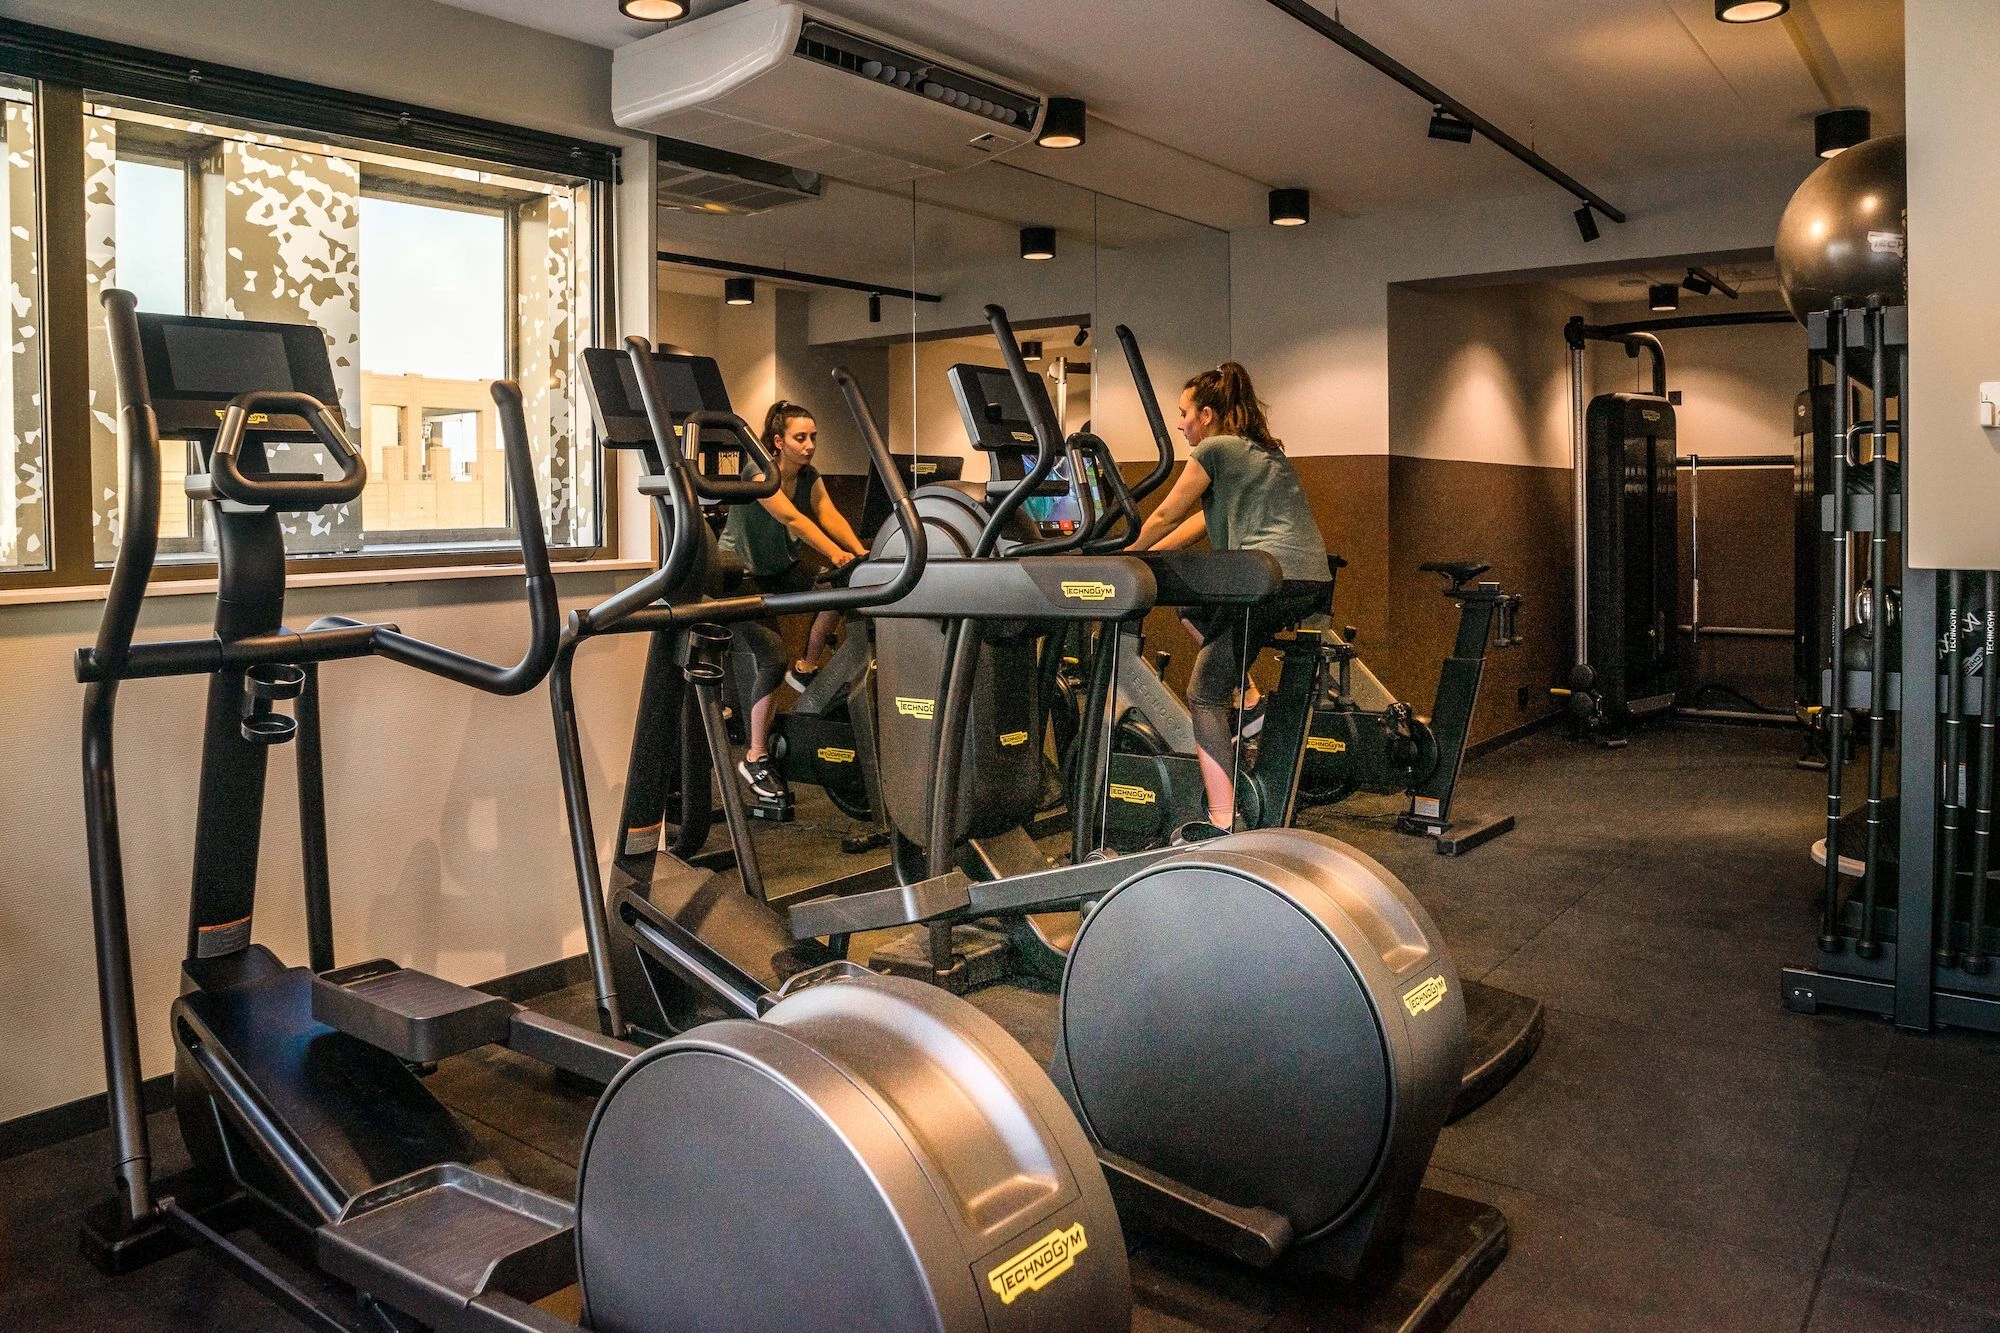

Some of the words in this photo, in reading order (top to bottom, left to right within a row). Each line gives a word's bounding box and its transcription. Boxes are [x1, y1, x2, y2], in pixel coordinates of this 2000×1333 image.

[1063, 585, 1112, 597] TECHNOGYM
[1949, 608, 1957, 652] TECHNOGYM
[1986, 610, 1995, 655] TECHNOGYM
[1404, 979, 1444, 1012] TECHNOGYM
[992, 1230, 1081, 1295] TECHNOGYM
